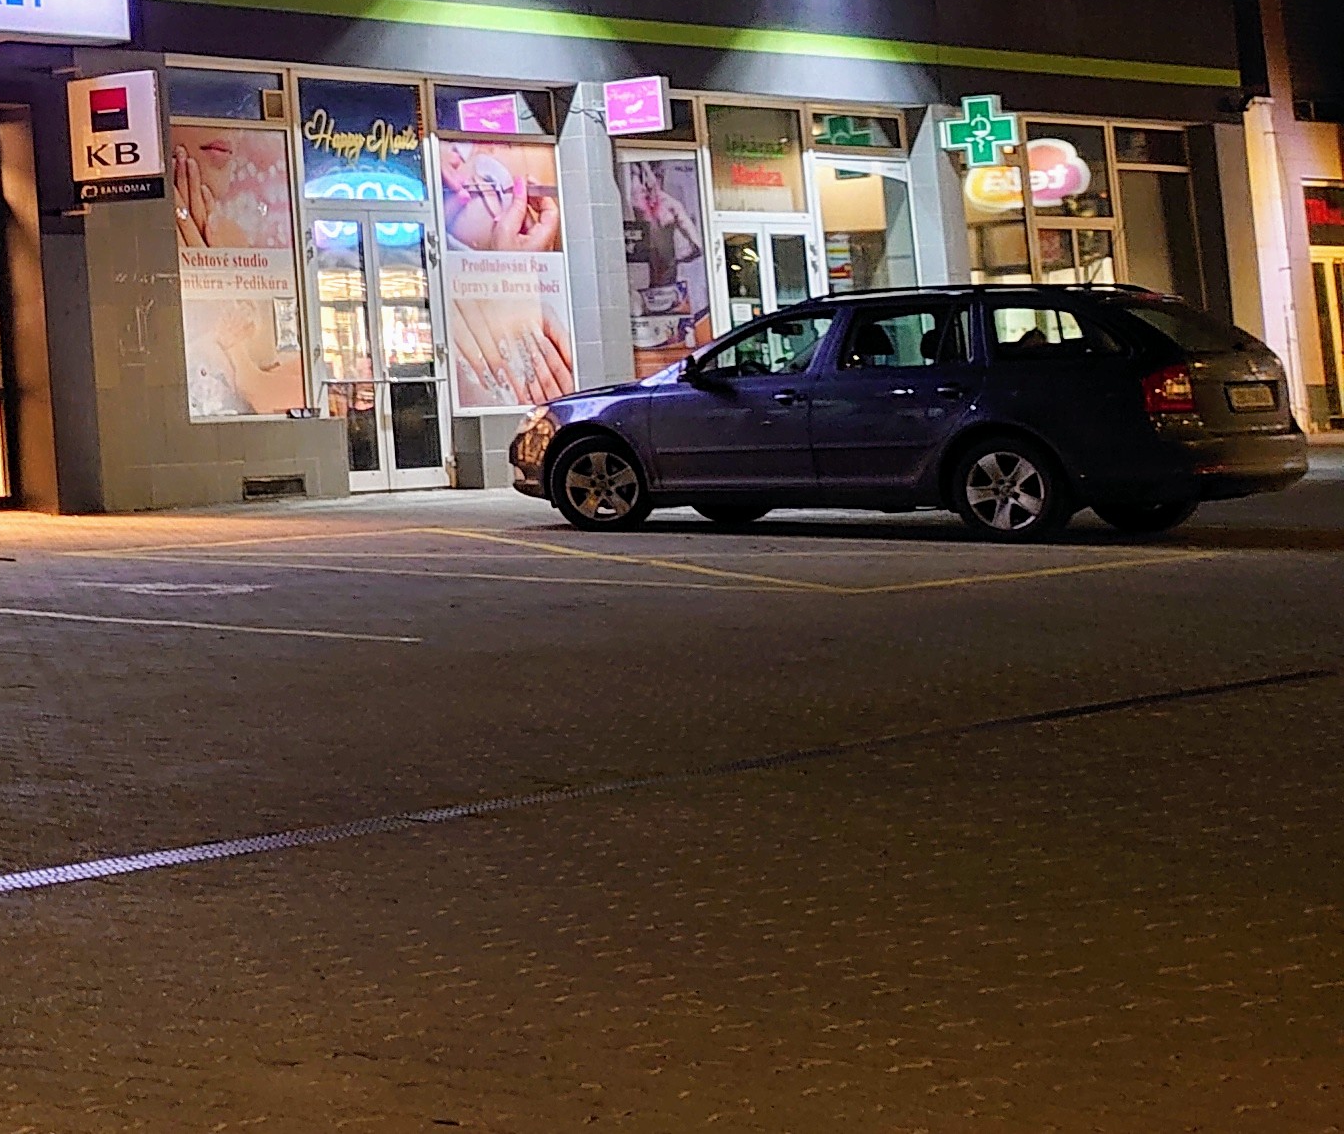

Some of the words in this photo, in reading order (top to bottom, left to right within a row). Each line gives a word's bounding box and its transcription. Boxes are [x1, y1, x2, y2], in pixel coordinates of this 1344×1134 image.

[304, 108, 365, 166] Happy
[366, 118, 419, 162] Nails
[86, 142, 141, 167] KB
[100, 183, 151, 195] BANKOMAT
[181, 252, 229, 267] Nehtové
[232, 253, 268, 267] studio
[461, 257, 527, 273] Prodlužování
[235, 274, 289, 290] Pedikúra
[501, 279, 531, 293] Barva
